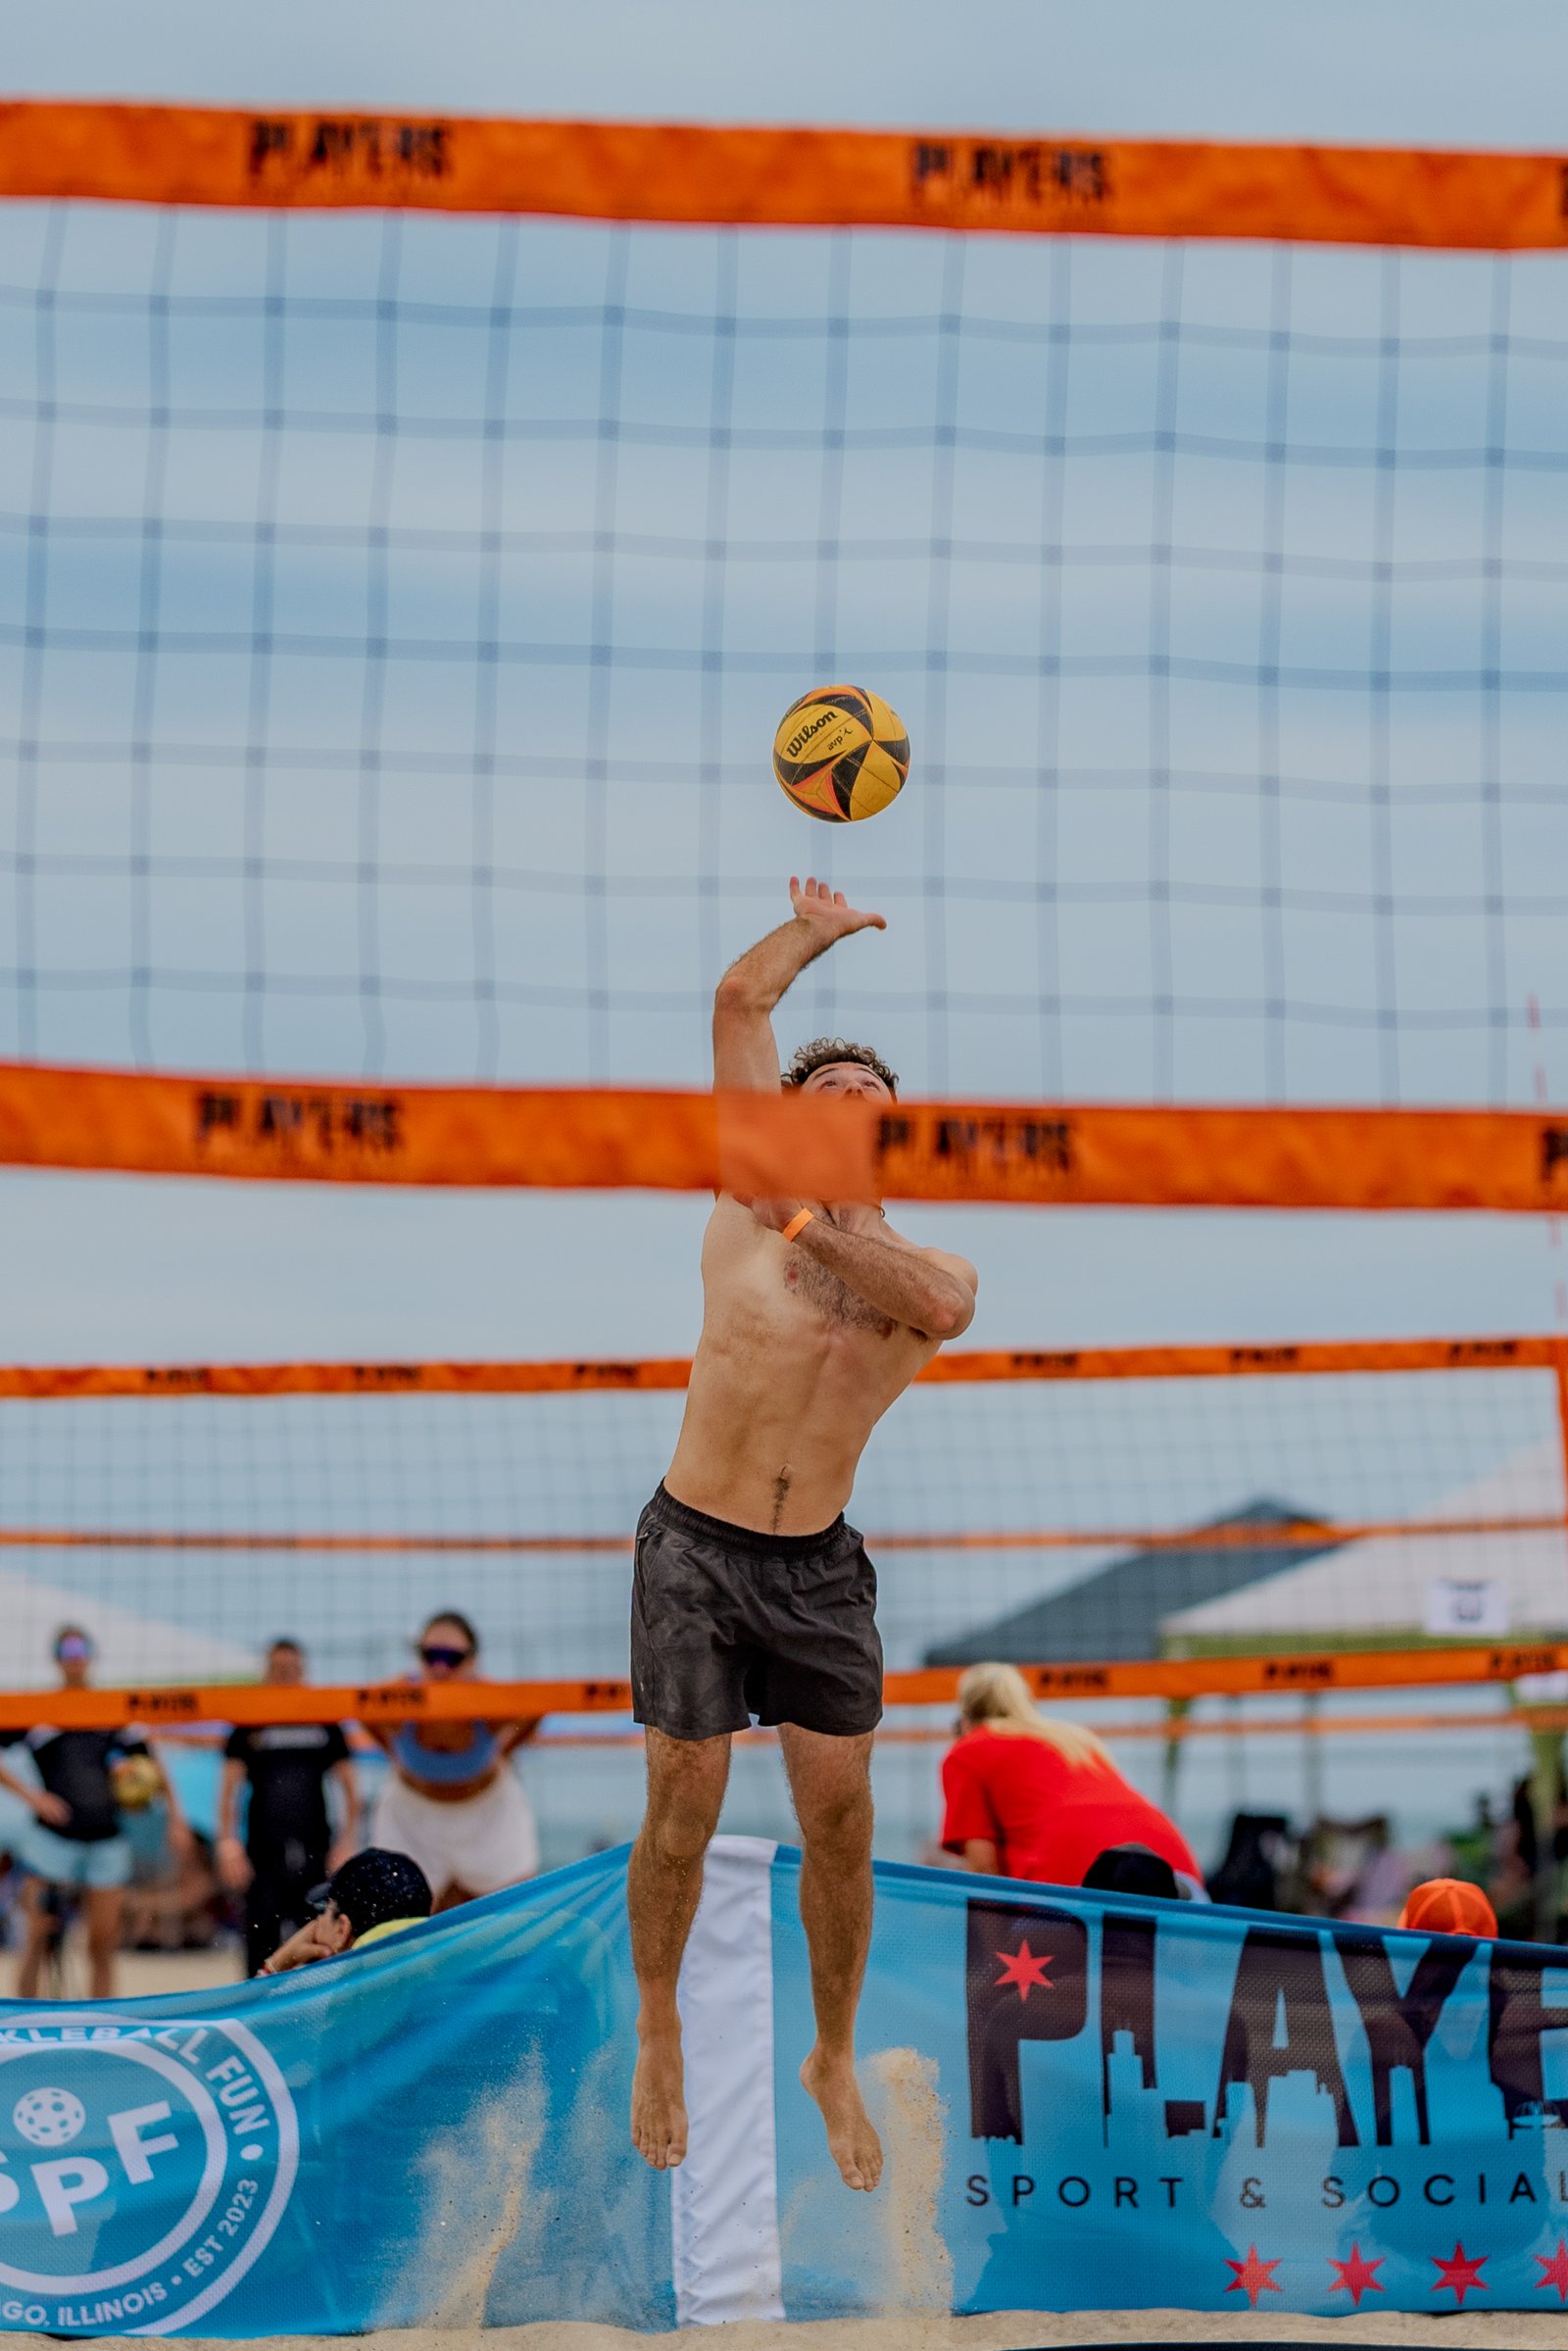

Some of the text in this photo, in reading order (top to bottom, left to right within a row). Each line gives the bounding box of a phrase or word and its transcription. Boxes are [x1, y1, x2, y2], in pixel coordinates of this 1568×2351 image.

[787, 711, 838, 758] Wilson
[828, 736, 843, 751] avp
[205, 2055, 270, 2136] FUN
[965, 2169, 1568, 2210] SPORT & SOCIAL
[57, 2280, 168, 2327] ILLINOIS
[182, 2234, 225, 2278] EST
[218, 2178, 260, 2238] 2023
